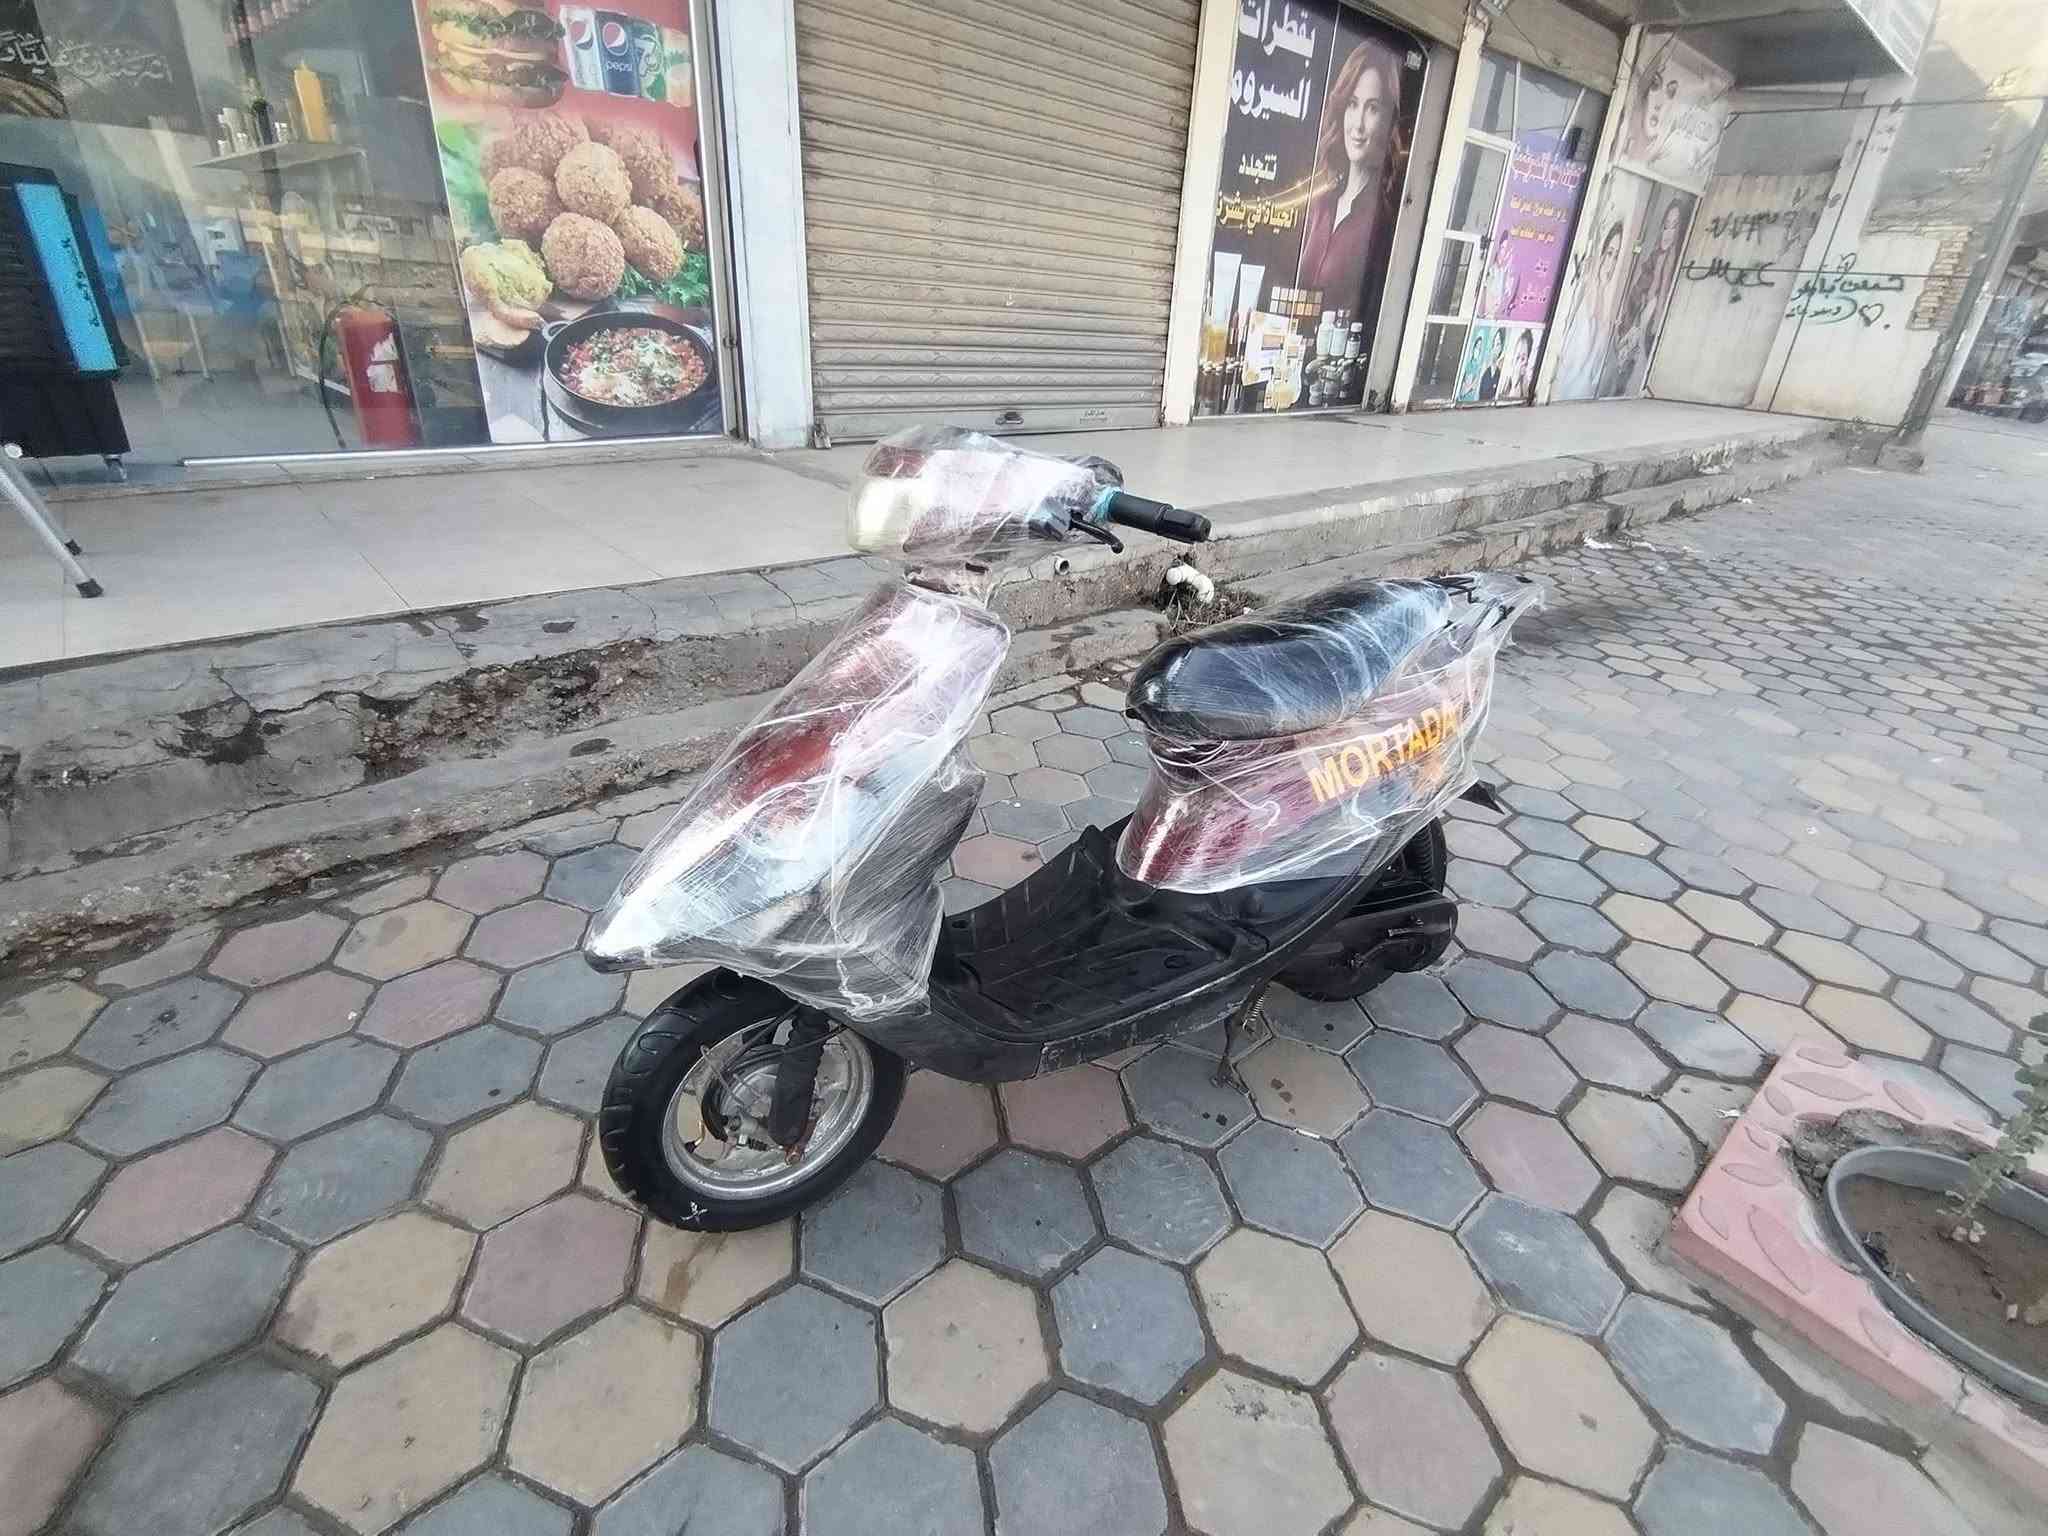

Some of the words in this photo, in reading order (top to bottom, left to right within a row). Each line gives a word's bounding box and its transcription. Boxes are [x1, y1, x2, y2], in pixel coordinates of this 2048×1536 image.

[1240, 0, 1316, 68] بقطرات
[606, 60, 633, 73] pepsi
[1231, 69, 1311, 120] السيروم
[1238, 153, 1278, 185] تتجدد
[1246, 196, 1262, 235] في
[1263, 200, 1298, 234] الحياة
